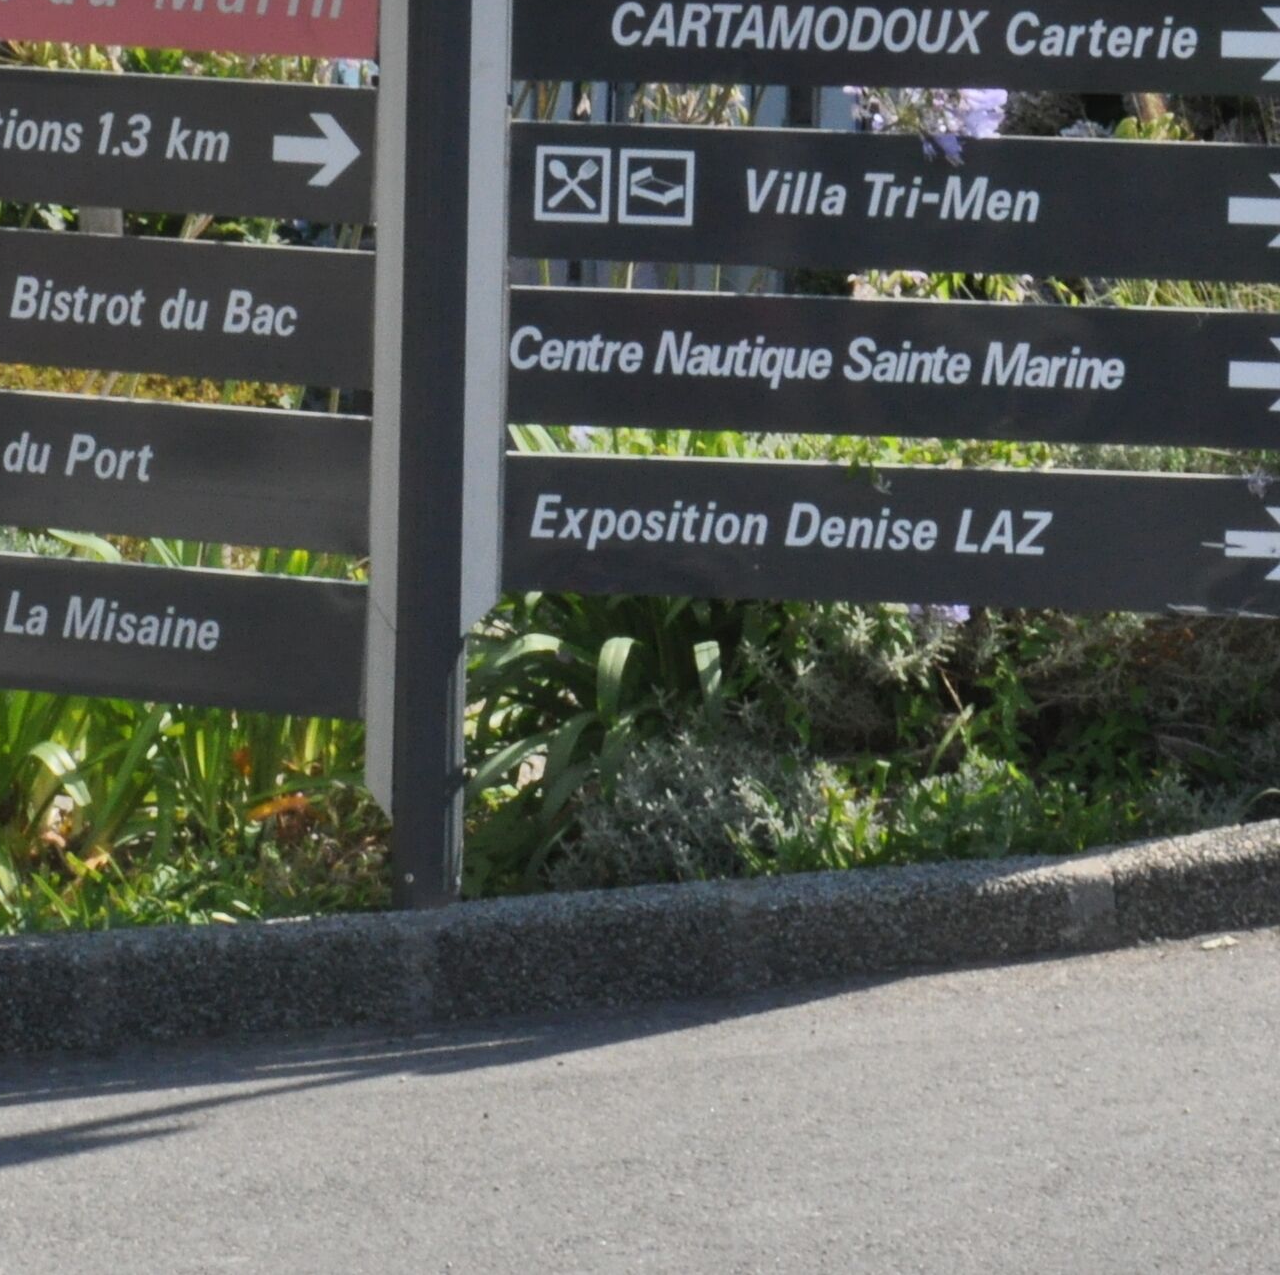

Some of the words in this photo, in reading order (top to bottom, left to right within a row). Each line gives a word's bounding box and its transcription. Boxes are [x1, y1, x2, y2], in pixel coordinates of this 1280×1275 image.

[611, 1, 990, 55] CARTAMODOUX
[1005, 11, 1198, 59] Carterie
[97, 112, 152, 158] 1.3
[165, 116, 230, 163] km
[746, 168, 847, 216] Villa
[864, 172, 1040, 223] Tri-Men
[9, 275, 146, 327] Bistrot
[159, 288, 209, 331] du
[222, 289, 298, 337] Bac
[508, 324, 645, 374] Centre
[653, 330, 833, 390] Nautique
[842, 336, 972, 385] Sainte
[981, 341, 1125, 390] Marine
[2, 431, 51, 475] du
[64, 433, 154, 483] Port
[530, 494, 768, 551] Exposition
[784, 502, 938, 551] Denise
[954, 508, 1053, 556] LAZ
[3, 590, 49, 636] La
[62, 595, 220, 651] Misaine
